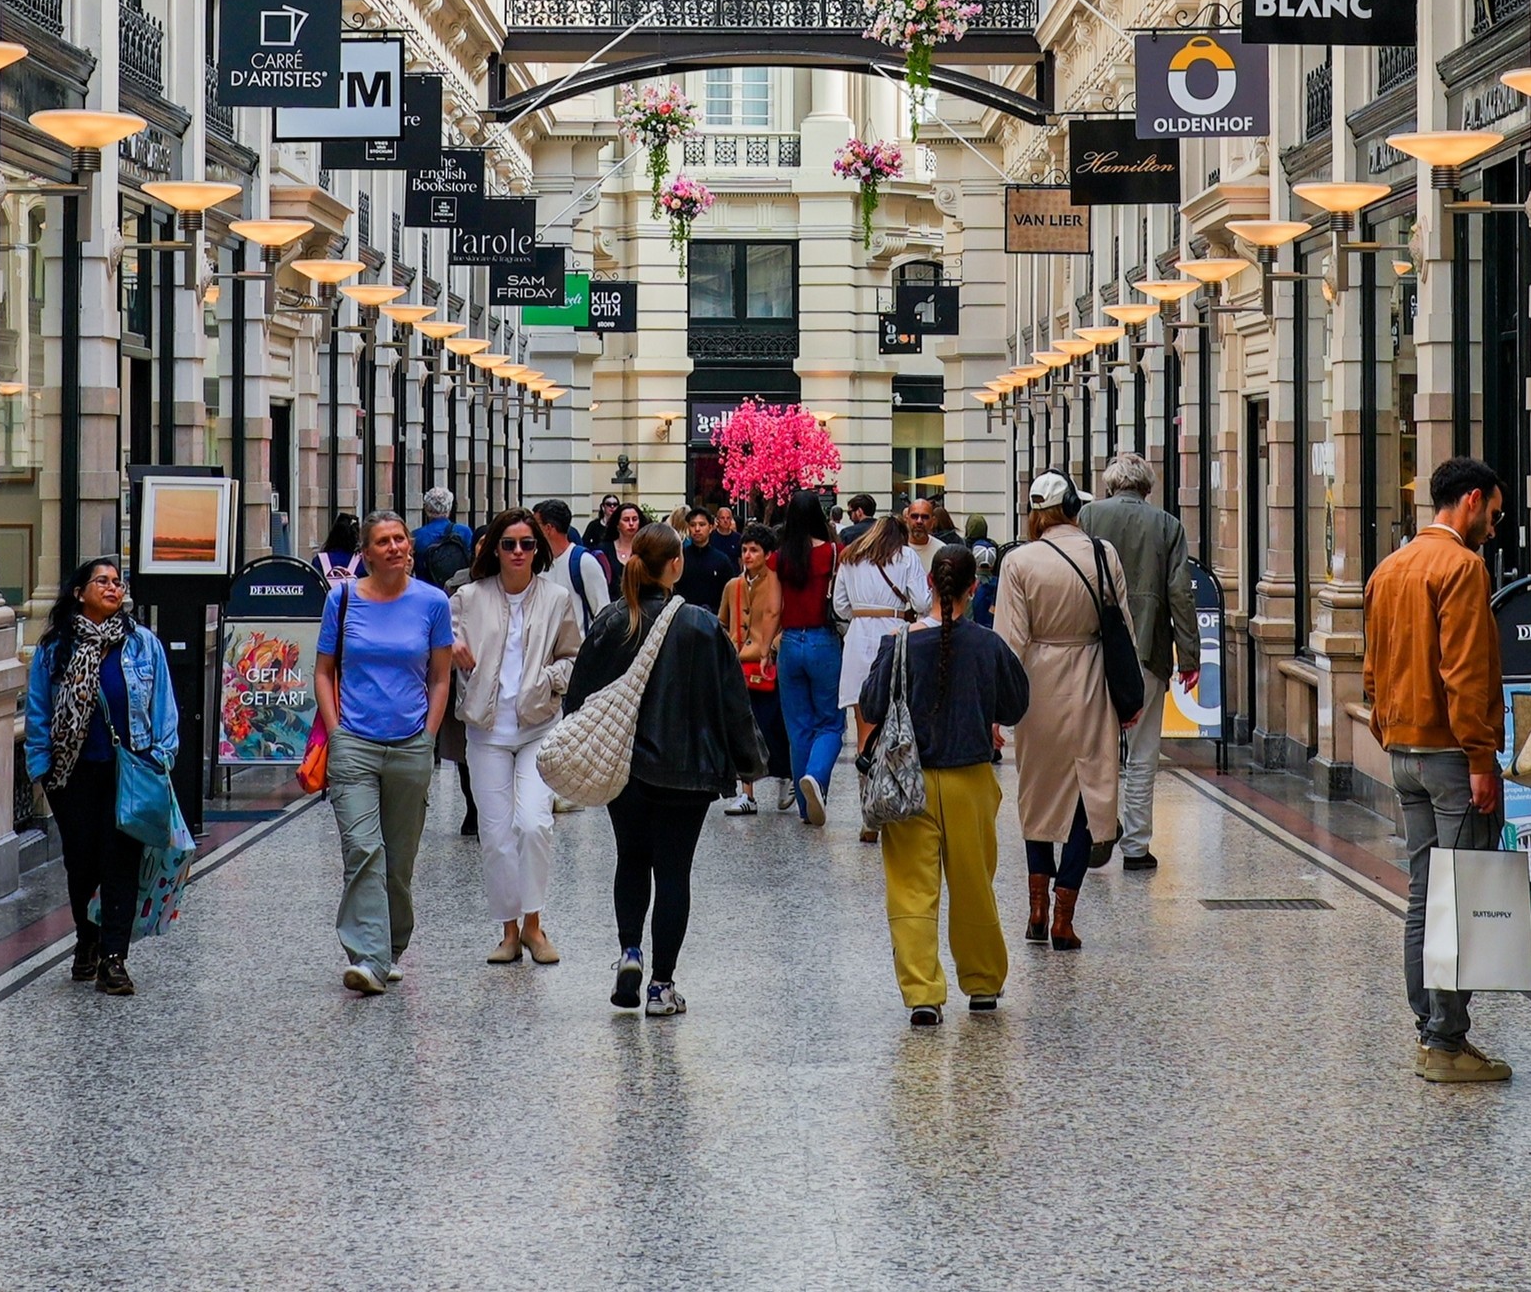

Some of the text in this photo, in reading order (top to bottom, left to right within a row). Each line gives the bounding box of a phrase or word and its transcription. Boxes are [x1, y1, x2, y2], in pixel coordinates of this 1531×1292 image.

[251, 49, 303, 69] CARRÉ
[340, 71, 391, 108] M
[1154, 116, 1253, 133] OLDENHOF
[440, 155, 456, 168] he
[1076, 151, 1175, 174] Hamilton
[419, 166, 467, 182] English
[412, 178, 478, 193] Bookstore
[1014, 214, 1083, 226] VAN LIER
[452, 227, 533, 255] Parole
[508, 275, 545, 286] SAM
[497, 288, 557, 299] FRIDAY
[591, 291, 621, 304] KILO
[697, 410, 734, 433] gall
[250, 585, 304, 596] DE PASSAGE
[246, 668, 302, 683] GET IN
[239, 691, 308, 705] GET ART
[1473, 910, 1512, 918] SUITSUPPLY
